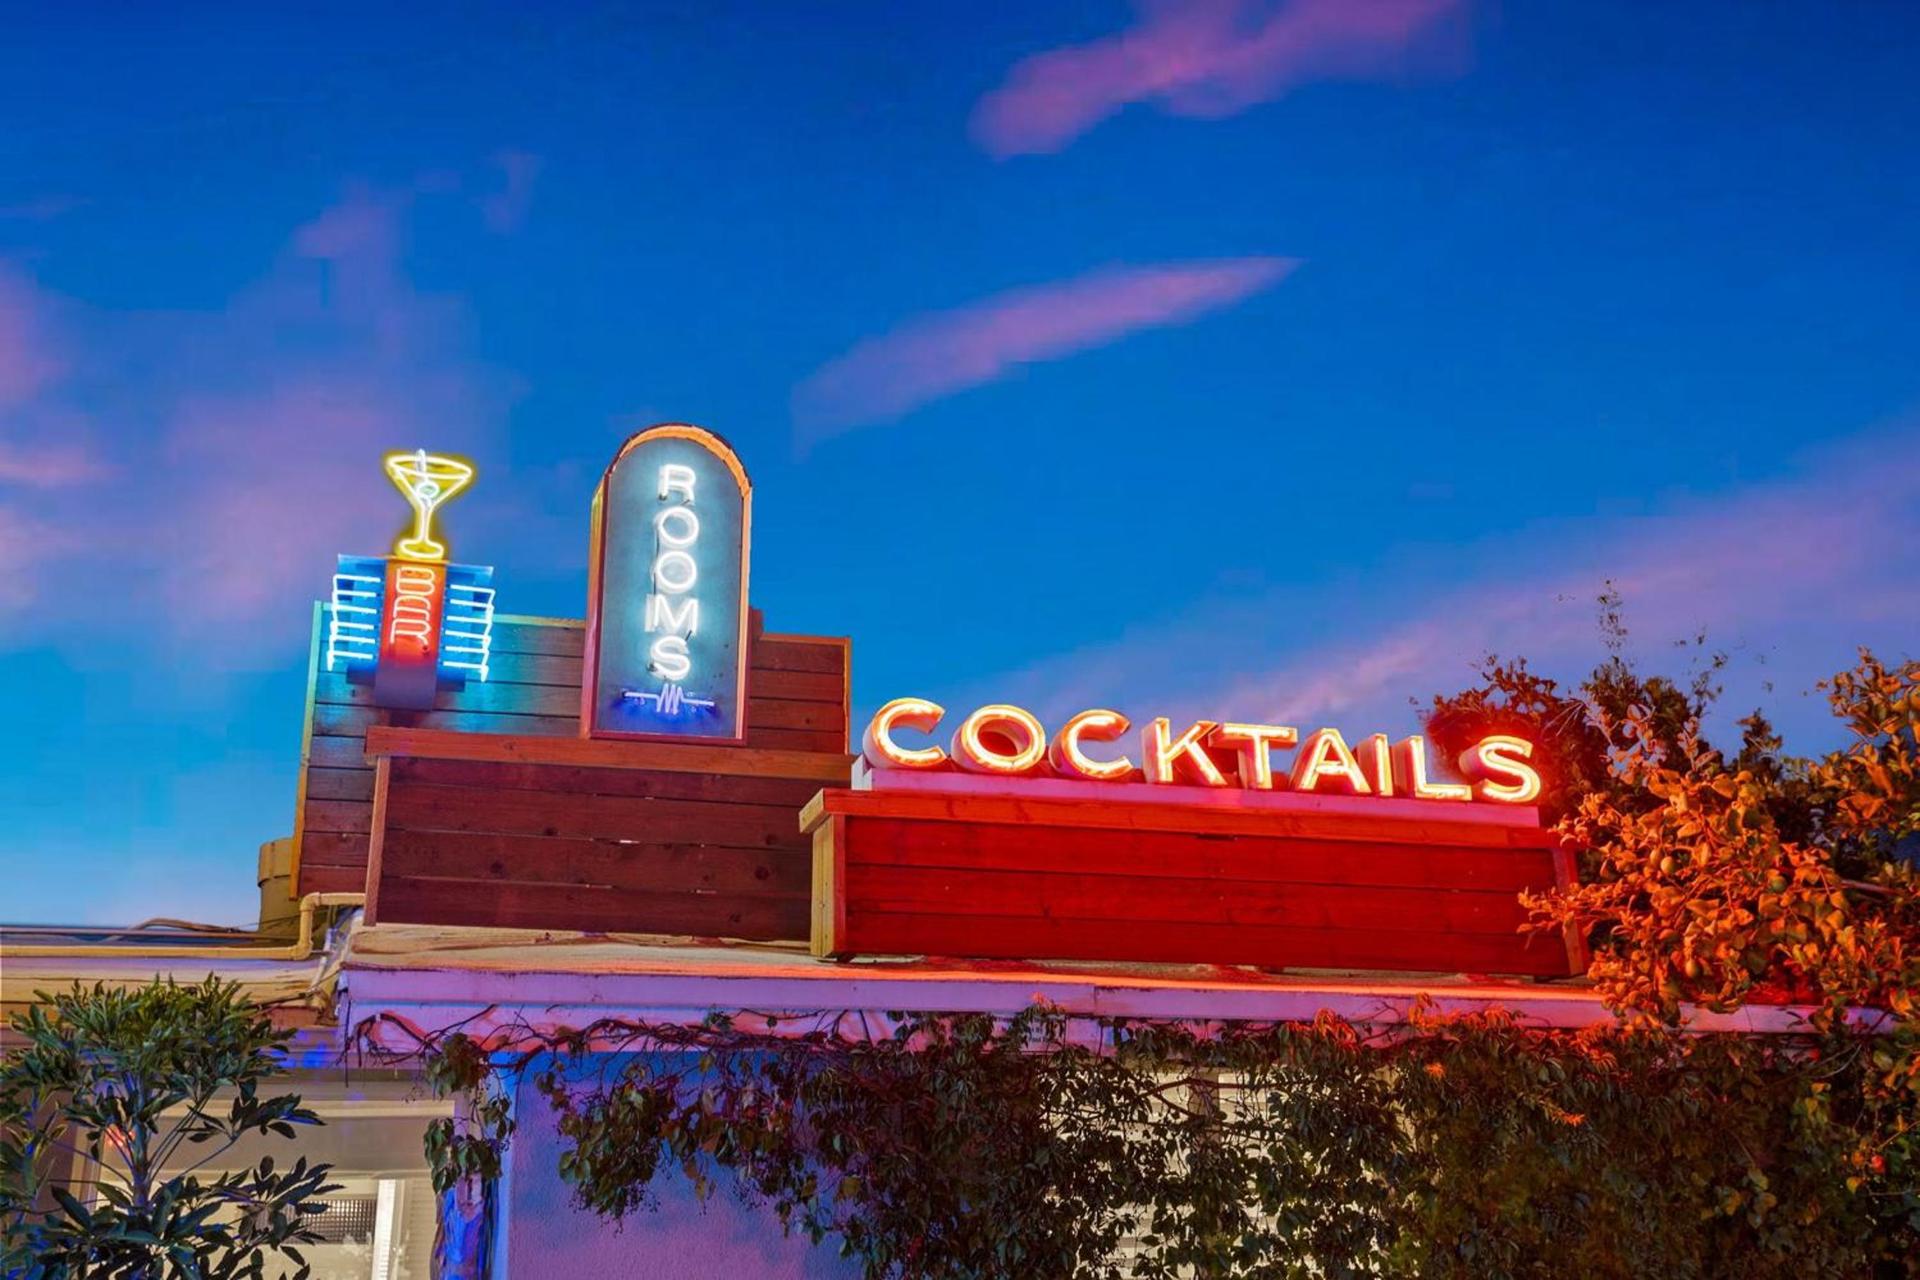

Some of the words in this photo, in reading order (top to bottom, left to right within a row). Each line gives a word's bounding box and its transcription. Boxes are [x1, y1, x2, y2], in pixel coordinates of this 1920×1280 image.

[390, 566, 435, 645] BAR
[645, 464, 699, 681] ROOMS
[864, 697, 1541, 802] COCKTAILS
